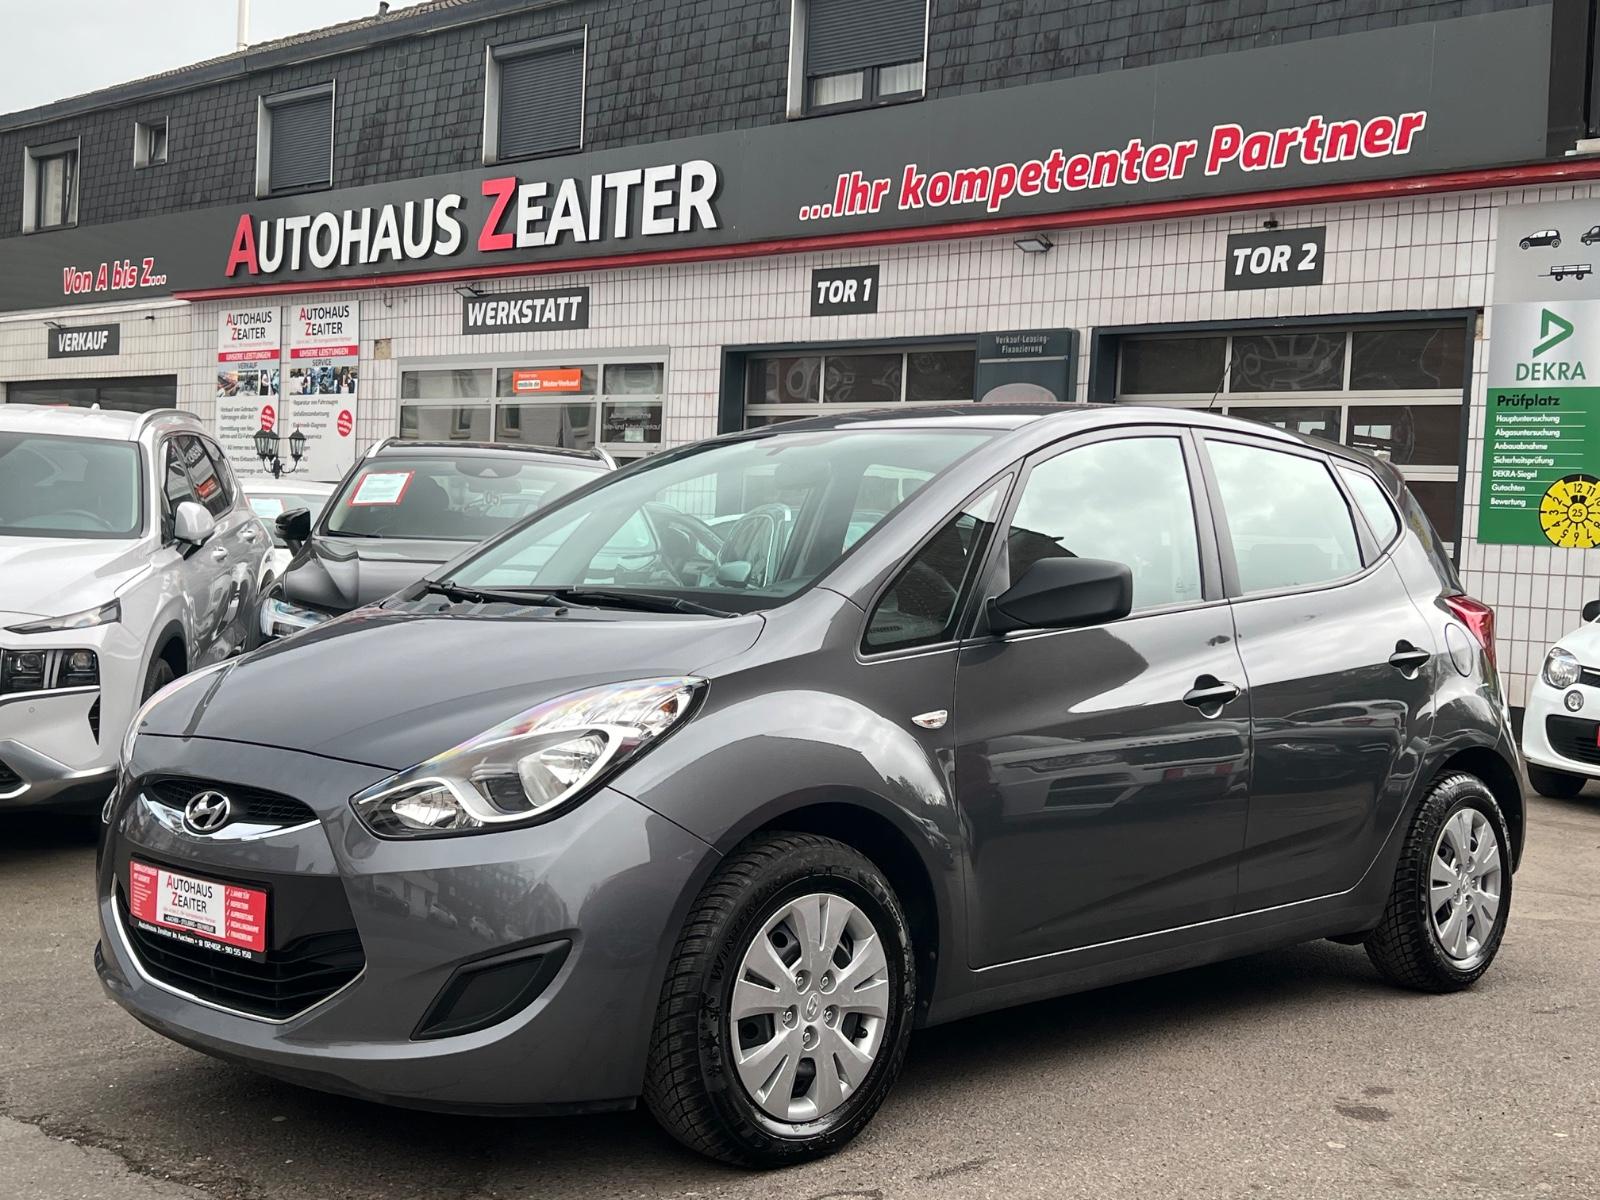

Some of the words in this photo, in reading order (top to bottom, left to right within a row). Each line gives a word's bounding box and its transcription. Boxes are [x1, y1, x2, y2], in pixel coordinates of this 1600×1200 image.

[898, 138, 1199, 213] kompetenter
[1204, 111, 1427, 176] Partner
[224, 193, 463, 278] AUTOHAUS
[477, 158, 719, 252] ZEAITER
[1232, 244, 1292, 276] TOR
[1298, 242, 1318, 271] 2
[63, 266, 93, 295] Von
[95, 263, 108, 292] A
[111, 259, 138, 290] bis
[816, 279, 858, 305] TOR
[861, 278, 873, 302] 1
[299, 305, 350, 322] AUTOHAUS
[467, 295, 582, 327] WERKSTATT
[226, 311, 272, 327] AUTOHAUS
[231, 327, 266, 341] ZEAITER
[305, 321, 343, 336] ZEAITER
[58, 330, 108, 352] VERKAUF
[312, 358, 332, 367] SERVICE
[1516, 361, 1586, 381] DEKRA
[1497, 393, 1560, 409] Prüfplatz
[1496, 414, 1560, 424] Hauptuntersuchung
[1495, 428, 1560, 438] Abgasuntersuchung
[1494, 442, 1548, 450] Anbauabnahme
[1493, 456, 1554, 466] Sicherheitsprüfung
[1492, 470, 1538, 480] DEKRA-Siegel
[1491, 483, 1526, 492] Gutachten
[1563, 487, 1569, 497] 1
[1573, 483, 1583, 493] 12
[1587, 486, 1596, 497] 11
[1490, 497, 1526, 507] Bewertung
[1553, 496, 1562, 505] 2
[1572, 508, 1583, 517] 25
[1561, 529, 1569, 538] 5
[166, 875, 213, 899] AUTOHAUS
[171, 891, 207, 914] ZEAITER
